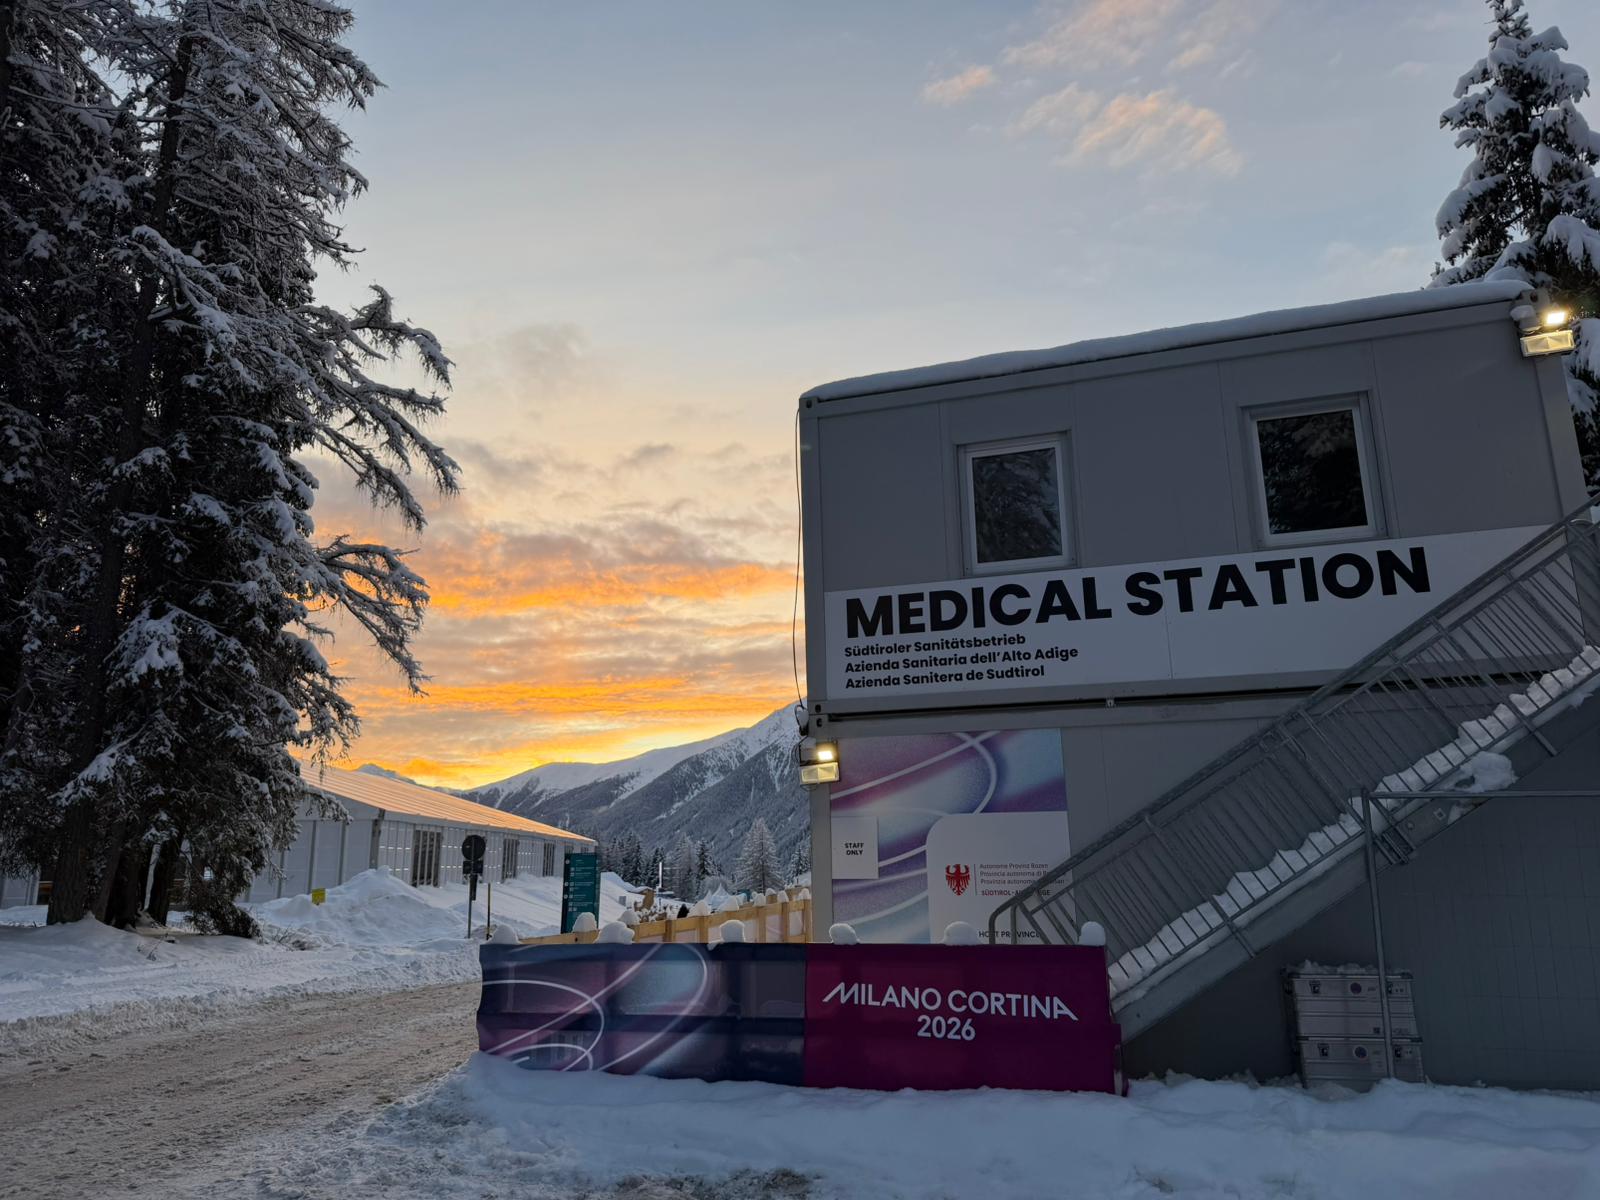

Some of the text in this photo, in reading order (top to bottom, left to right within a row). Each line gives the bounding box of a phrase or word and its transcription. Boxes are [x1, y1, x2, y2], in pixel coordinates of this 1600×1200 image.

[846, 546, 1431, 638] MEDICAL STATION
[844, 633, 1026, 657] Südtiroler Sanitätsbetrieb
[845, 660, 900, 673] Azienda
[902, 653, 967, 669] Sanitaria
[1034, 646, 1078, 662] Adige
[845, 665, 1044, 689] Azienda Sanitera de Sudtirol
[1001, 930, 1040, 938] PRVINC
[822, 982, 1079, 1021] MILANO CORTINA
[917, 1015, 976, 1041] 2026
